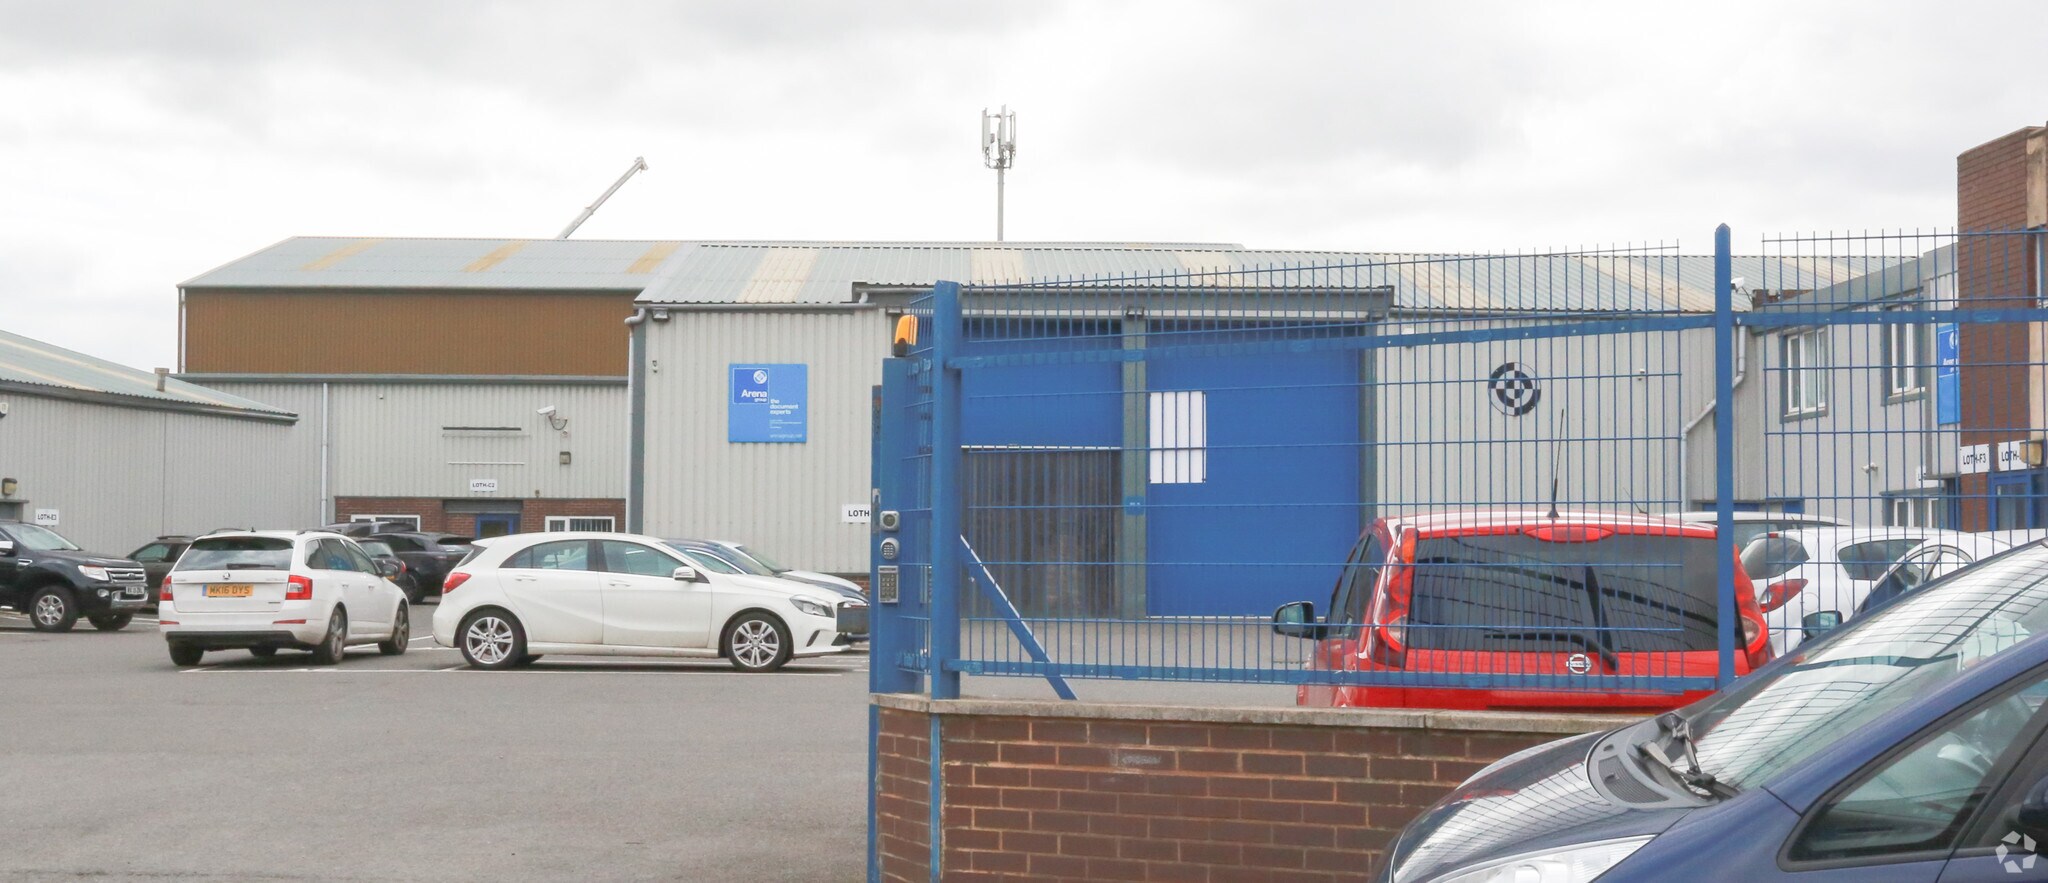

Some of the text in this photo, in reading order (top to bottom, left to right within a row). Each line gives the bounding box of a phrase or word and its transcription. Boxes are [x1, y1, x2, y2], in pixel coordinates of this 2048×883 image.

[741, 389, 767, 398] Arena
[1962, 453, 1987, 465] LOTH-F3
[2001, 450, 2021, 462] LOTH-
[209, 585, 250, 595] MK16 DYS
